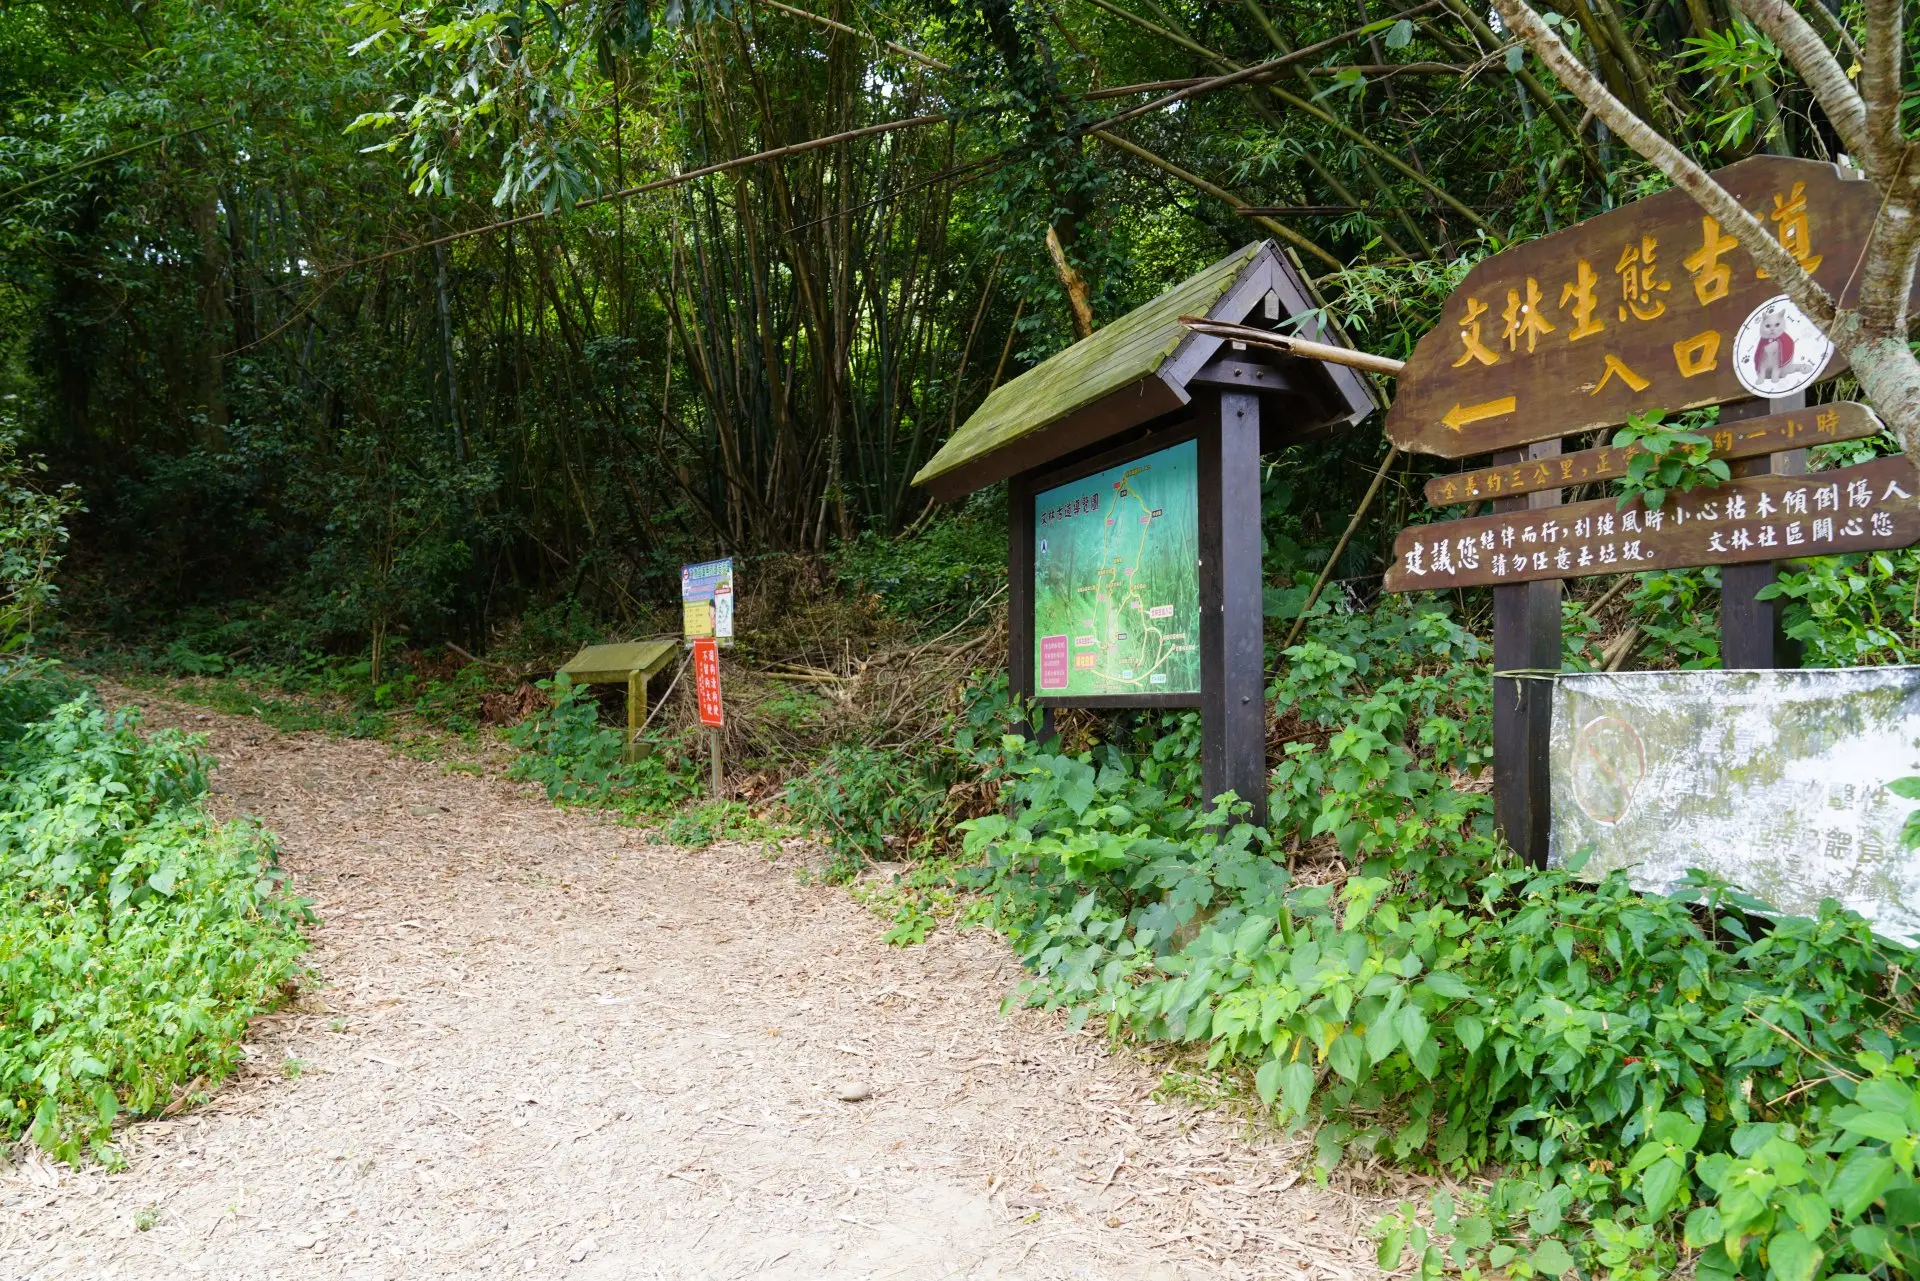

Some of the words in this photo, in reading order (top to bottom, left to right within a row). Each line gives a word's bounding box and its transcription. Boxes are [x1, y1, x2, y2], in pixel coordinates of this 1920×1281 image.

[1452, 180, 1823, 369] 文林生態古道
[1590, 329, 1721, 397] 入口
